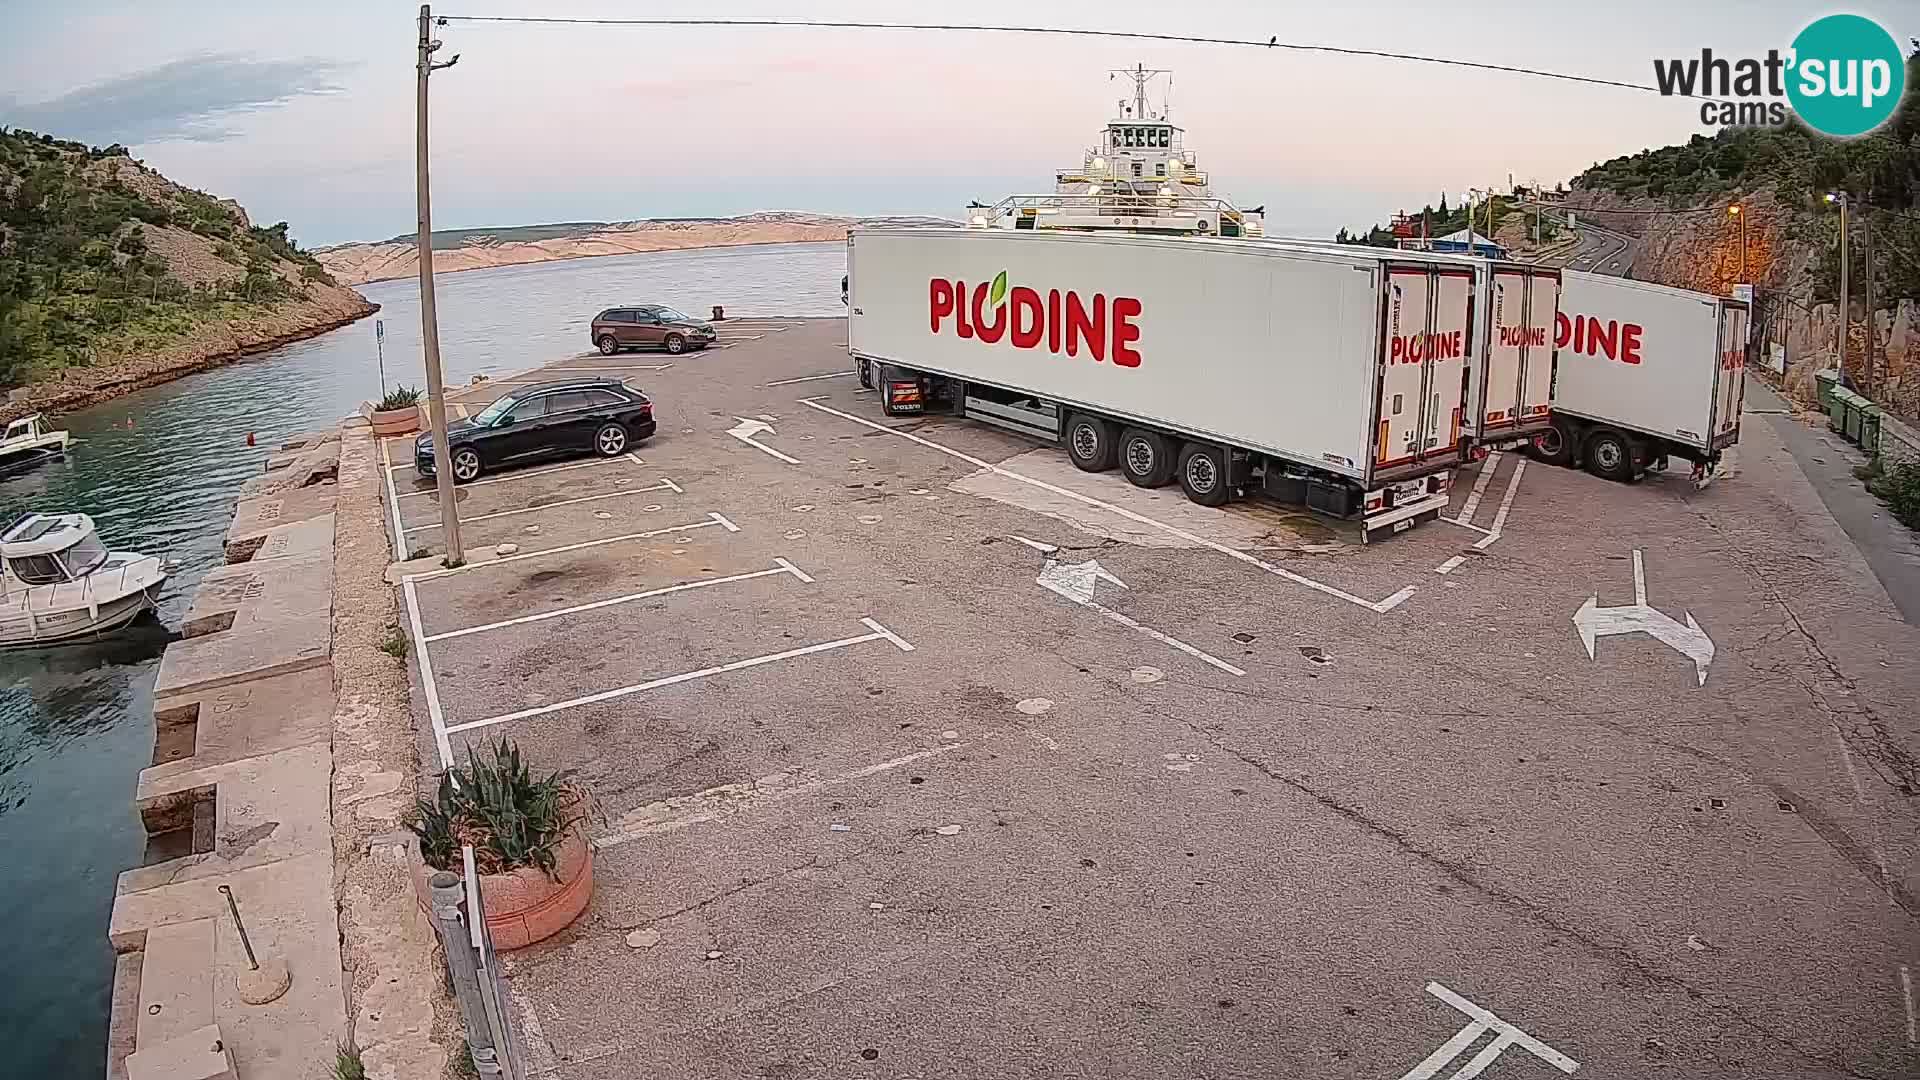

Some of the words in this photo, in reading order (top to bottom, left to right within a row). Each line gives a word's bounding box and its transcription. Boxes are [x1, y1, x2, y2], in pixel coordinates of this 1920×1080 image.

[929, 270, 1142, 368] PLODINE
[1499, 326, 1546, 347] PLODINE
[1390, 330, 1461, 366] PLODINE
